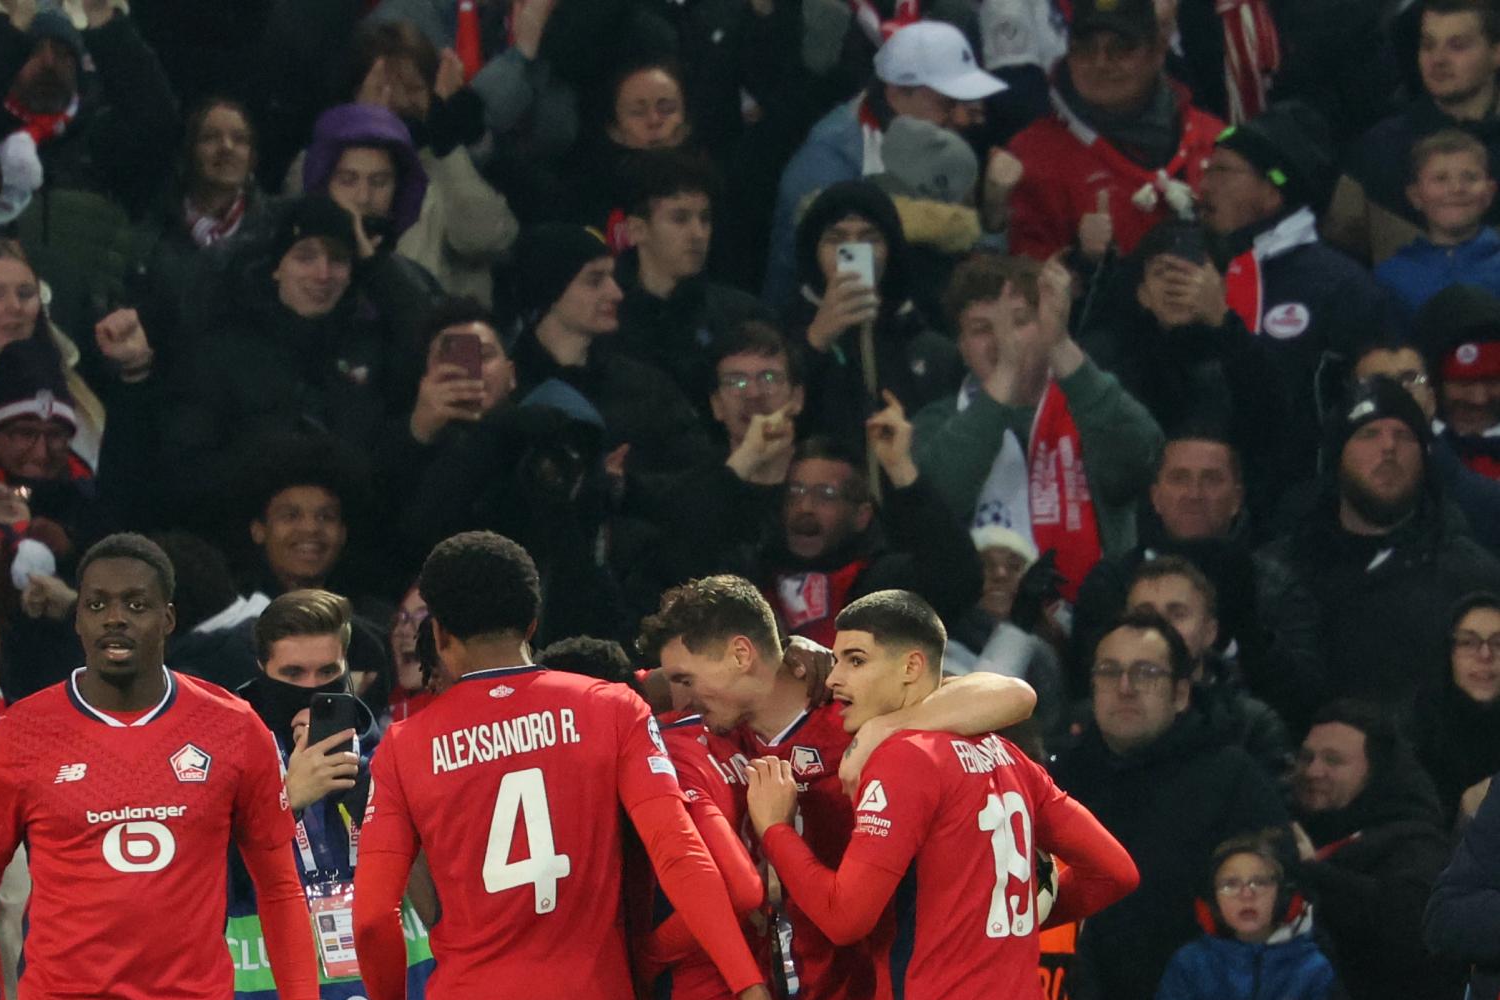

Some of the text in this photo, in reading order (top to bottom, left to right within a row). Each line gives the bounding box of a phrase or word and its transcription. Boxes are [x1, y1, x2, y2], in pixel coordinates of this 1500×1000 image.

[431, 708, 581, 775] ALEXSANDRO R.
[180, 771, 203, 780] LOSC
[86, 804, 188, 824] boulanger
[482, 767, 571, 915] 4
[977, 790, 1035, 938] 19
